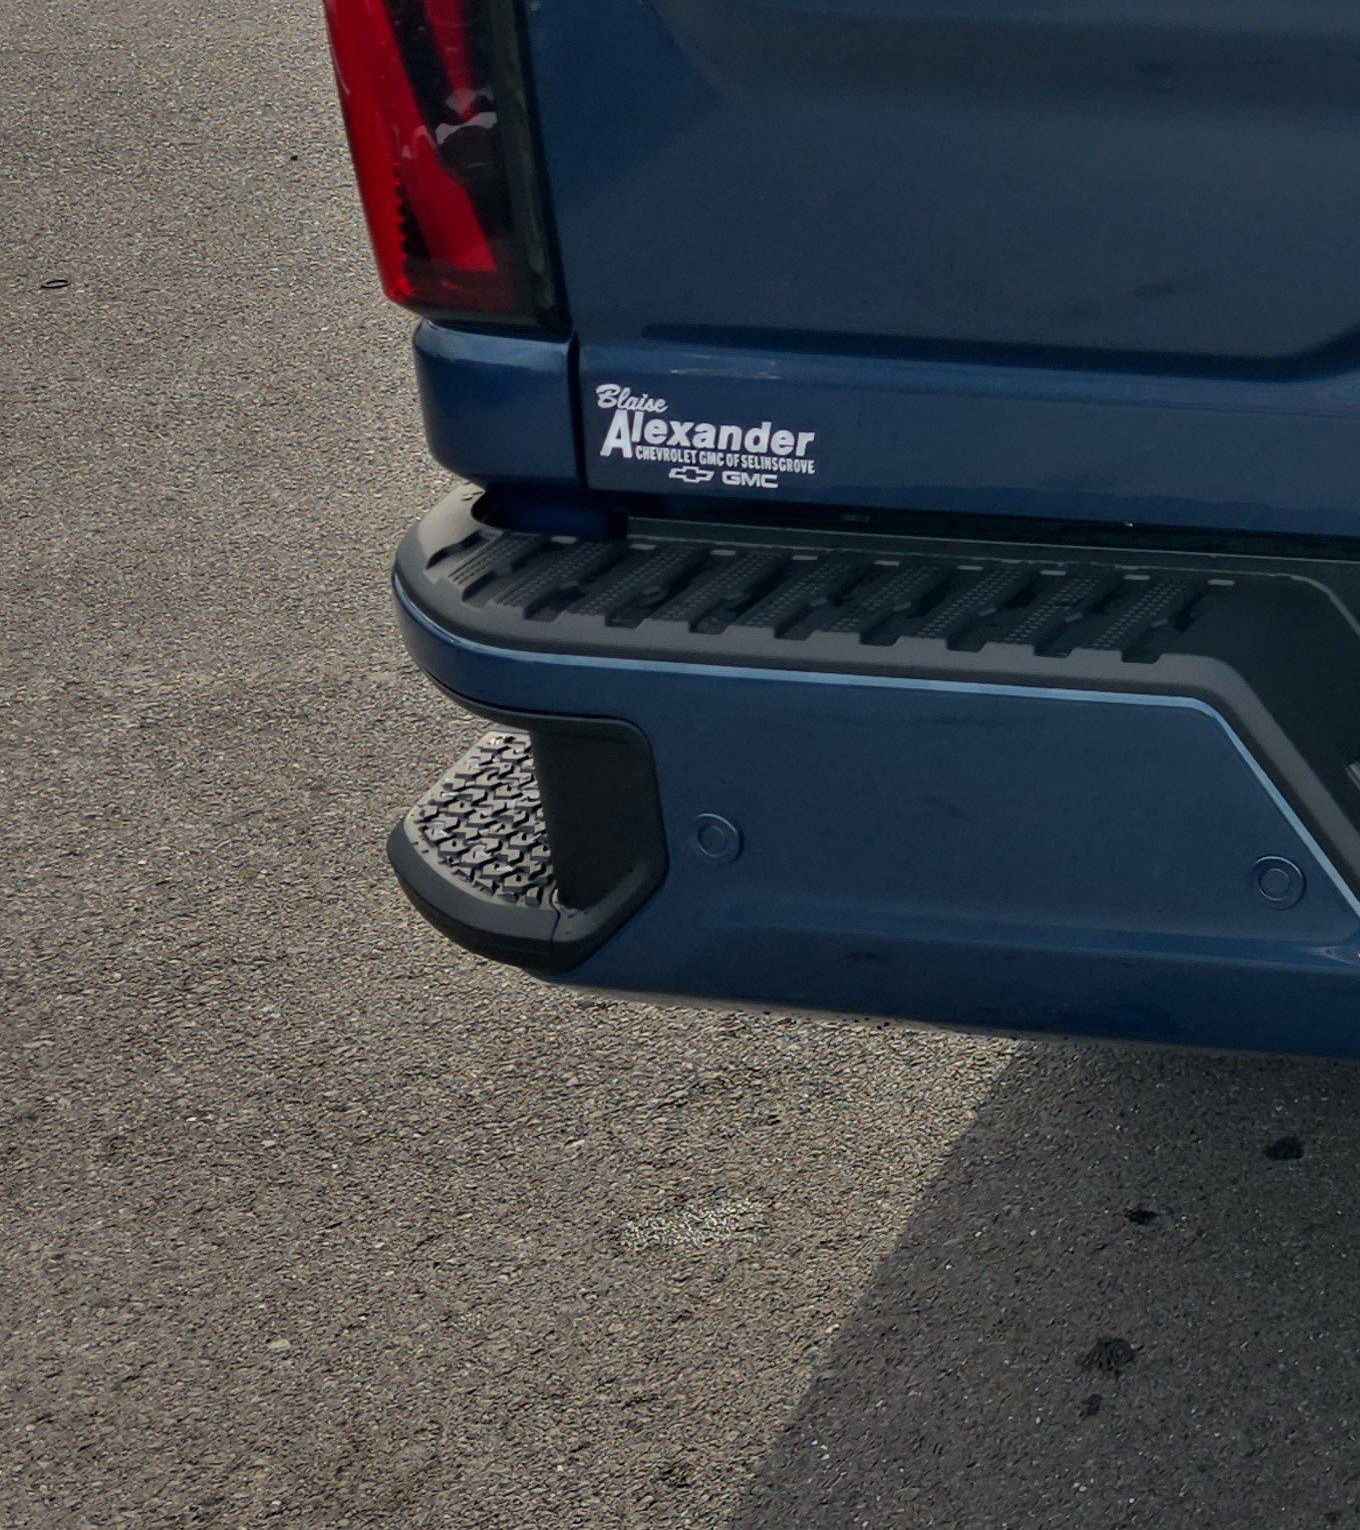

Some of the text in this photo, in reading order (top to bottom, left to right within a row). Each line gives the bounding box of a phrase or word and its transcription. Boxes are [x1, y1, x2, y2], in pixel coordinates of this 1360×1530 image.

[595, 383, 668, 414] Blaise
[600, 409, 815, 459] Alexander
[635, 445, 815, 475] CHEVROLET GMC OF SELINSGROVE
[721, 470, 779, 489] GMC
